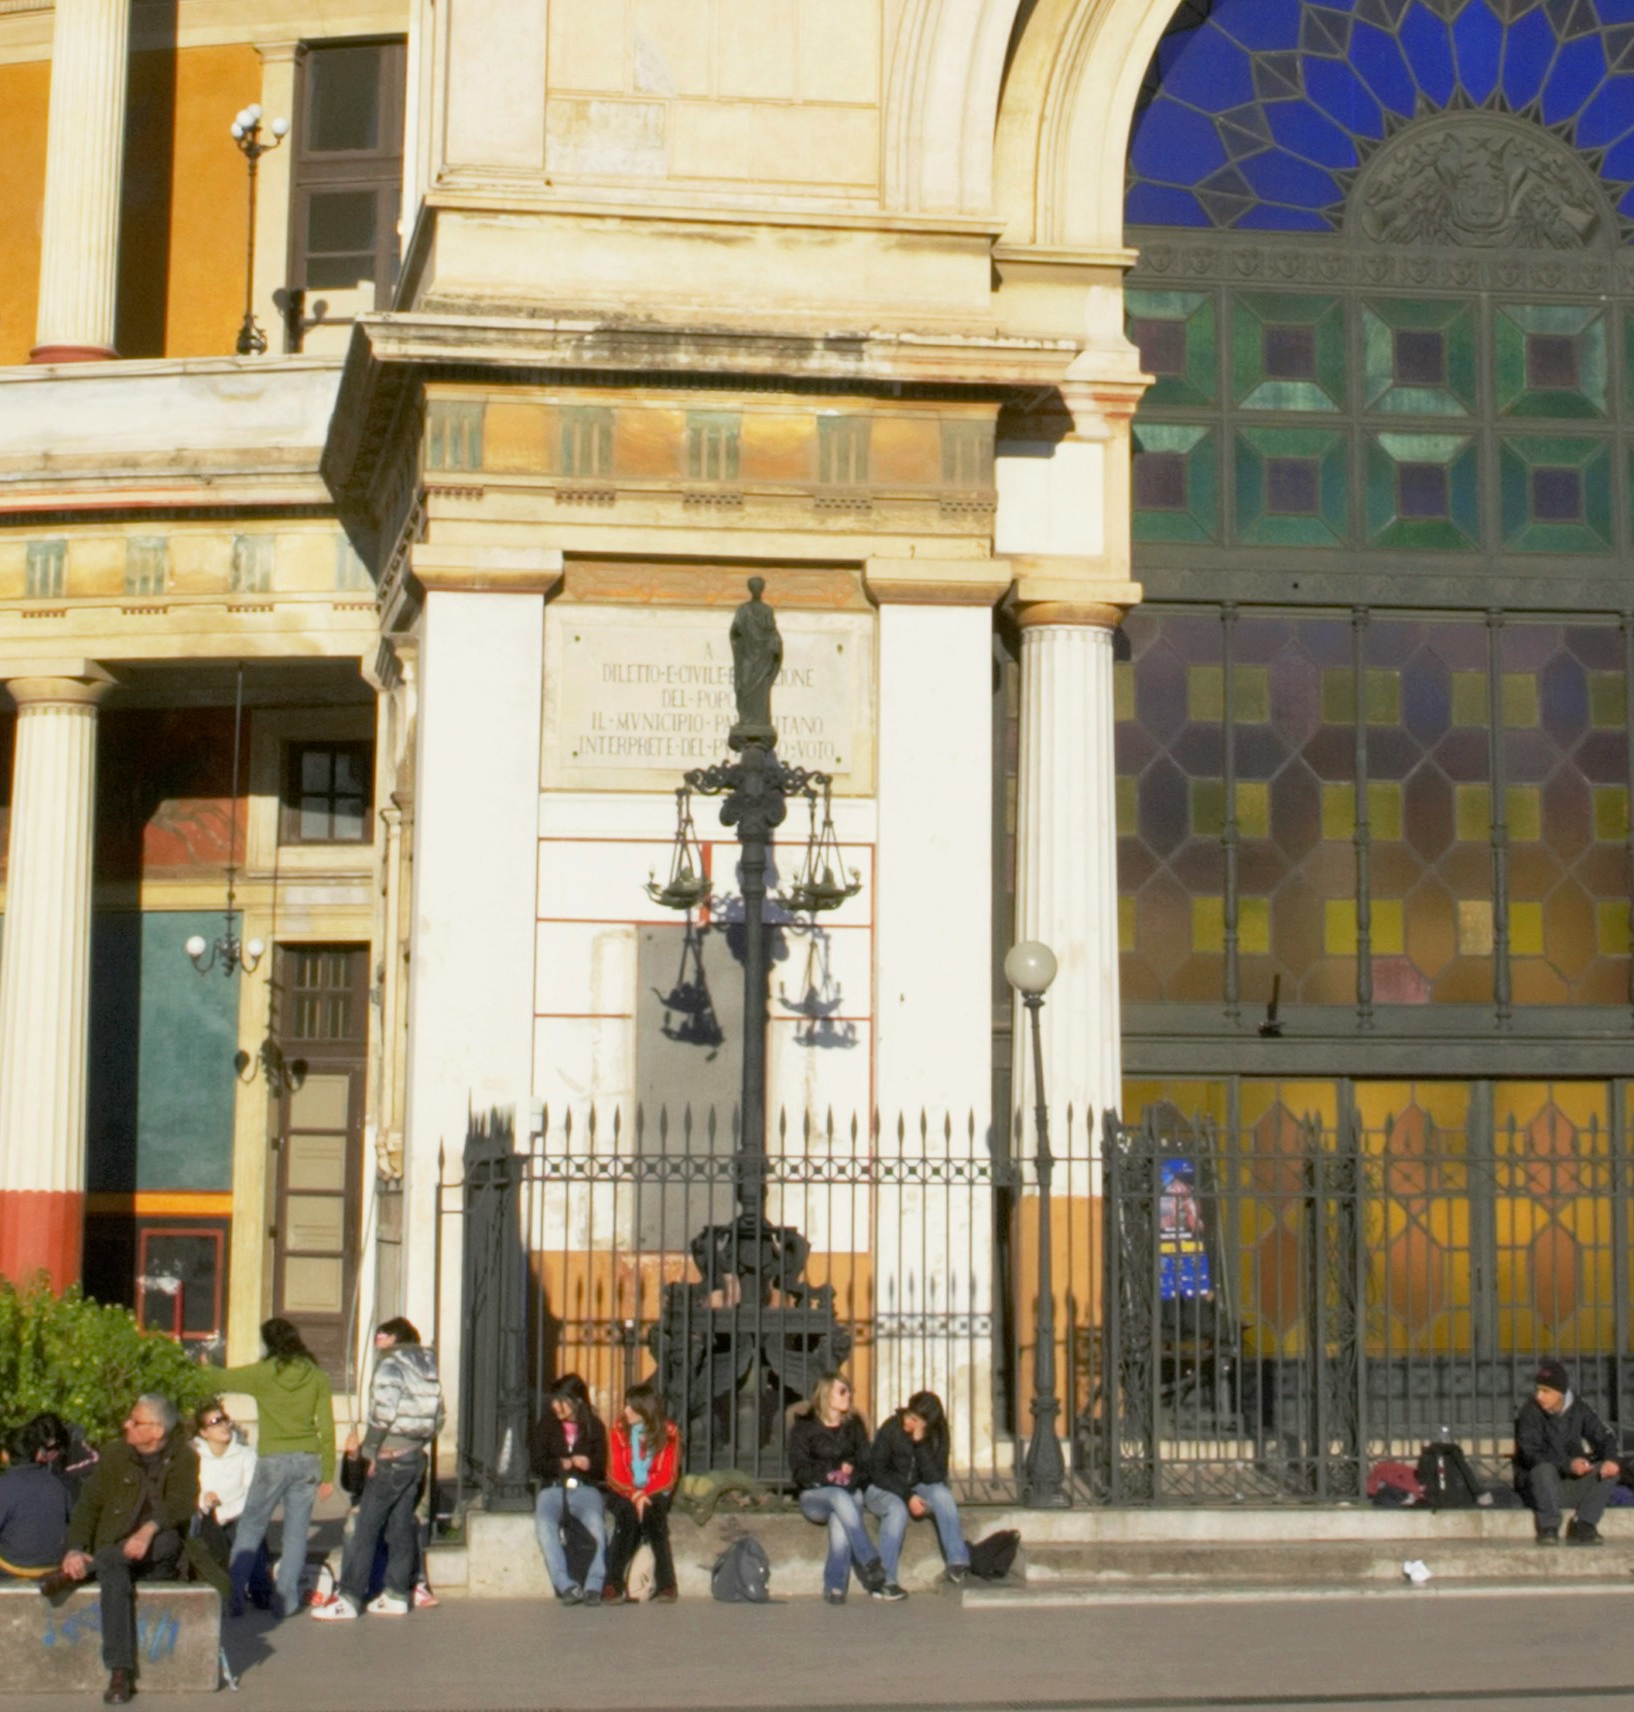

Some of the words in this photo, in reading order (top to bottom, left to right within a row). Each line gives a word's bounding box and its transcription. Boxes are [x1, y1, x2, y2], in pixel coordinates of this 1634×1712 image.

[703, 641, 714, 661] A
[602, 663, 660, 684] DILETTO
[678, 665, 725, 685] CIVILE
[661, 688, 687, 708] DEL
[697, 690, 738, 709] POPO
[591, 711, 606, 731] IL
[617, 712, 704, 732] MVNICIPIO
[579, 735, 674, 757] INTERPRETE
[681, 738, 705, 757] DEL
[796, 741, 835, 760] VOTO
